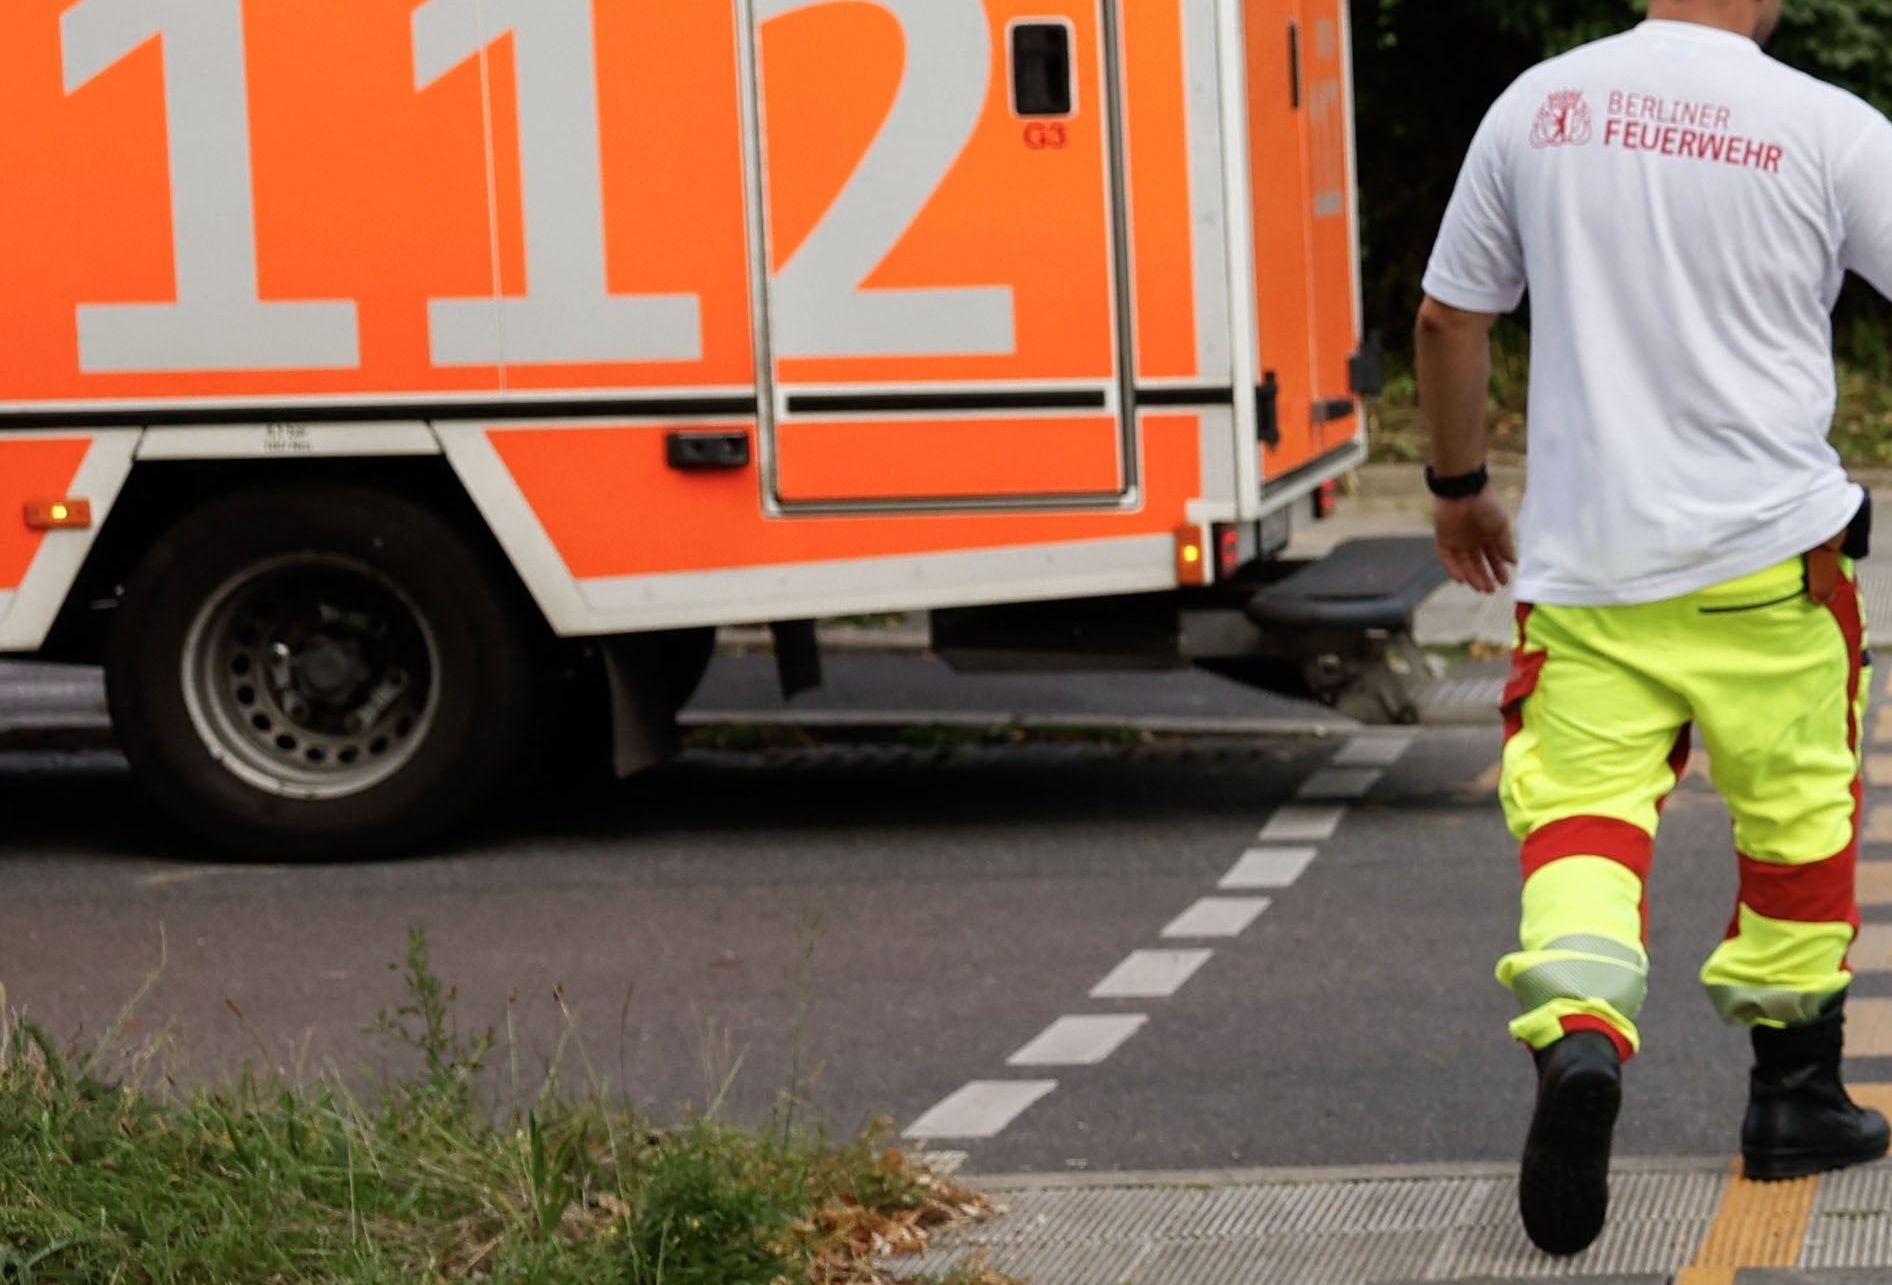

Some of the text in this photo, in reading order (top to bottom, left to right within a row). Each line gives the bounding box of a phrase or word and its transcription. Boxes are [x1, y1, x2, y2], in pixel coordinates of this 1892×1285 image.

[1607, 90, 1731, 131] BERLINER
[1023, 121, 1067, 151] G3
[1604, 118, 1784, 173] FEUERWEHR
